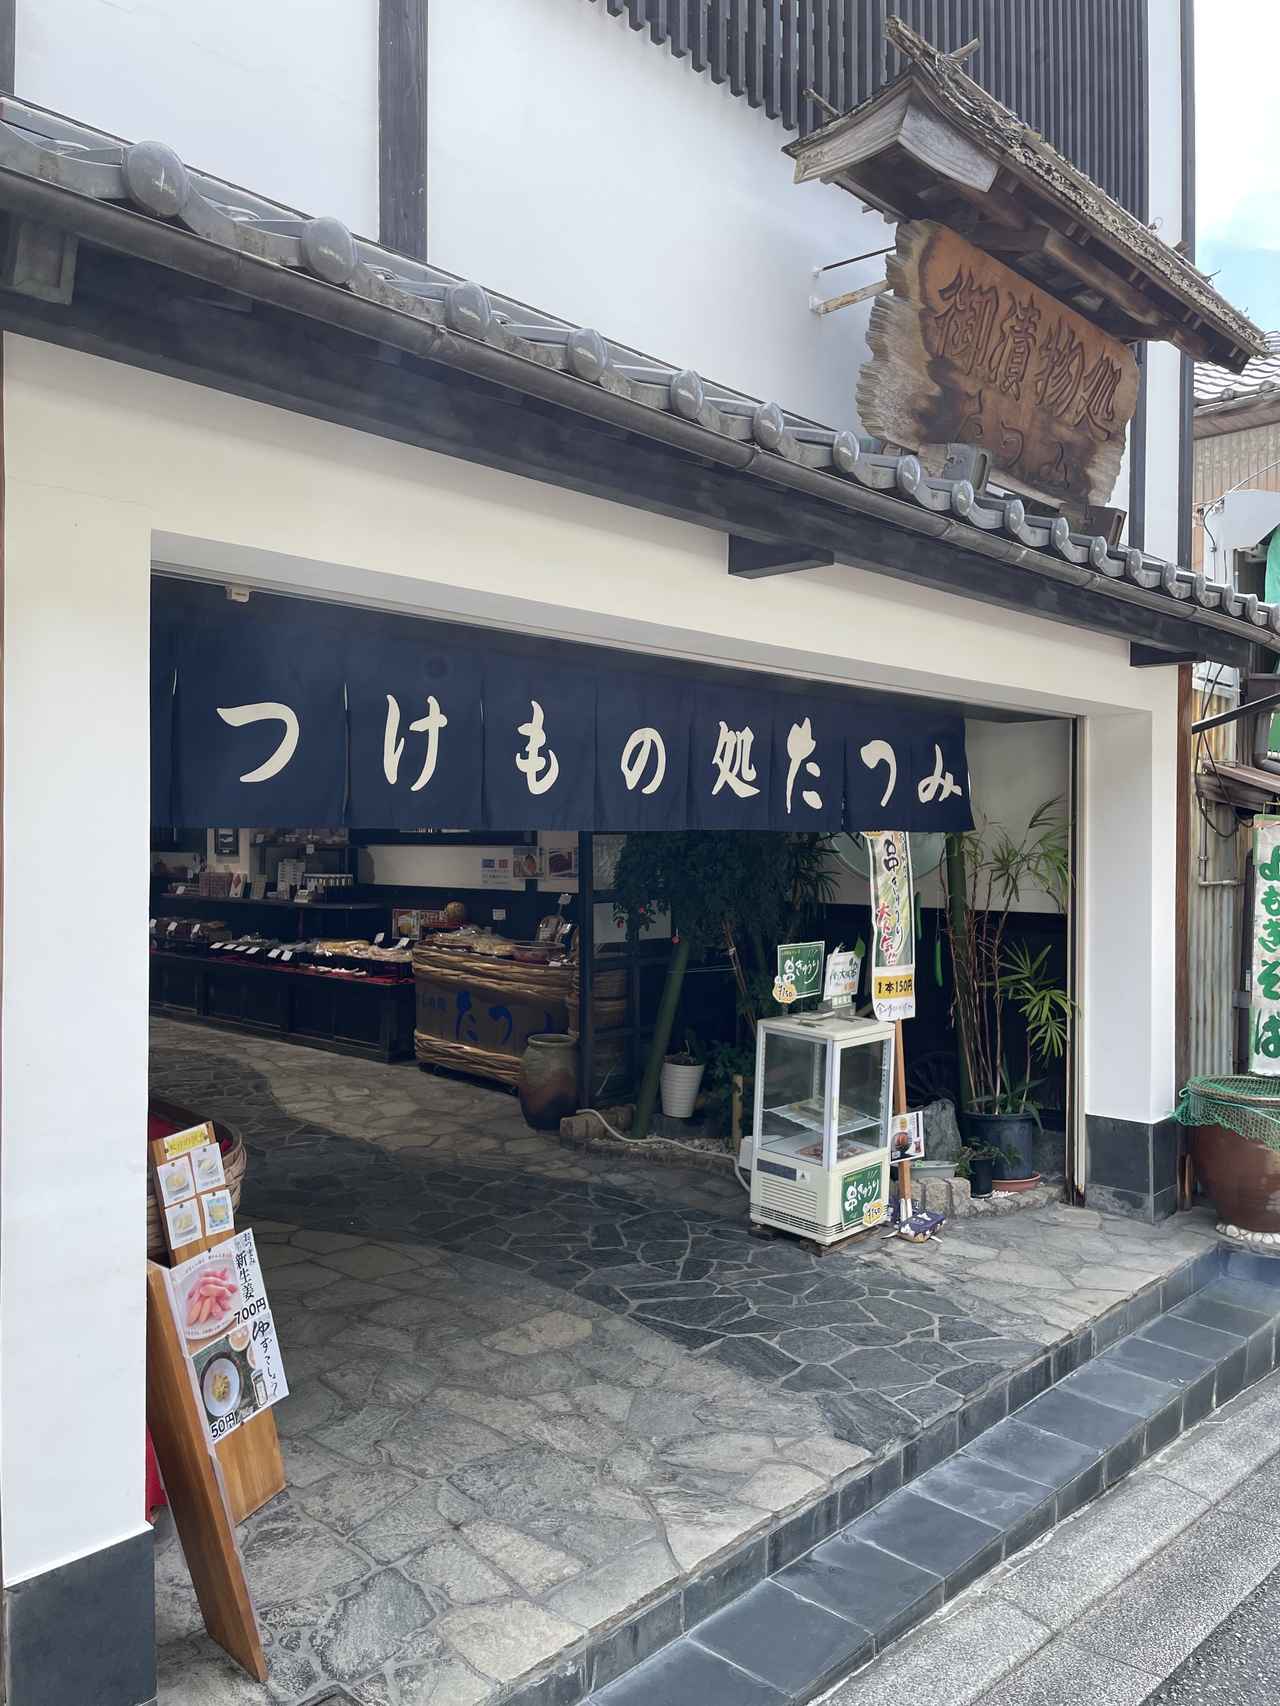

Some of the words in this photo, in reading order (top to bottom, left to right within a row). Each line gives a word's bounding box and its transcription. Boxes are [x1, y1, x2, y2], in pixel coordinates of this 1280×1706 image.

[235, 1250, 255, 1303] 新生姜
[234, 1297, 267, 1325] 700円
